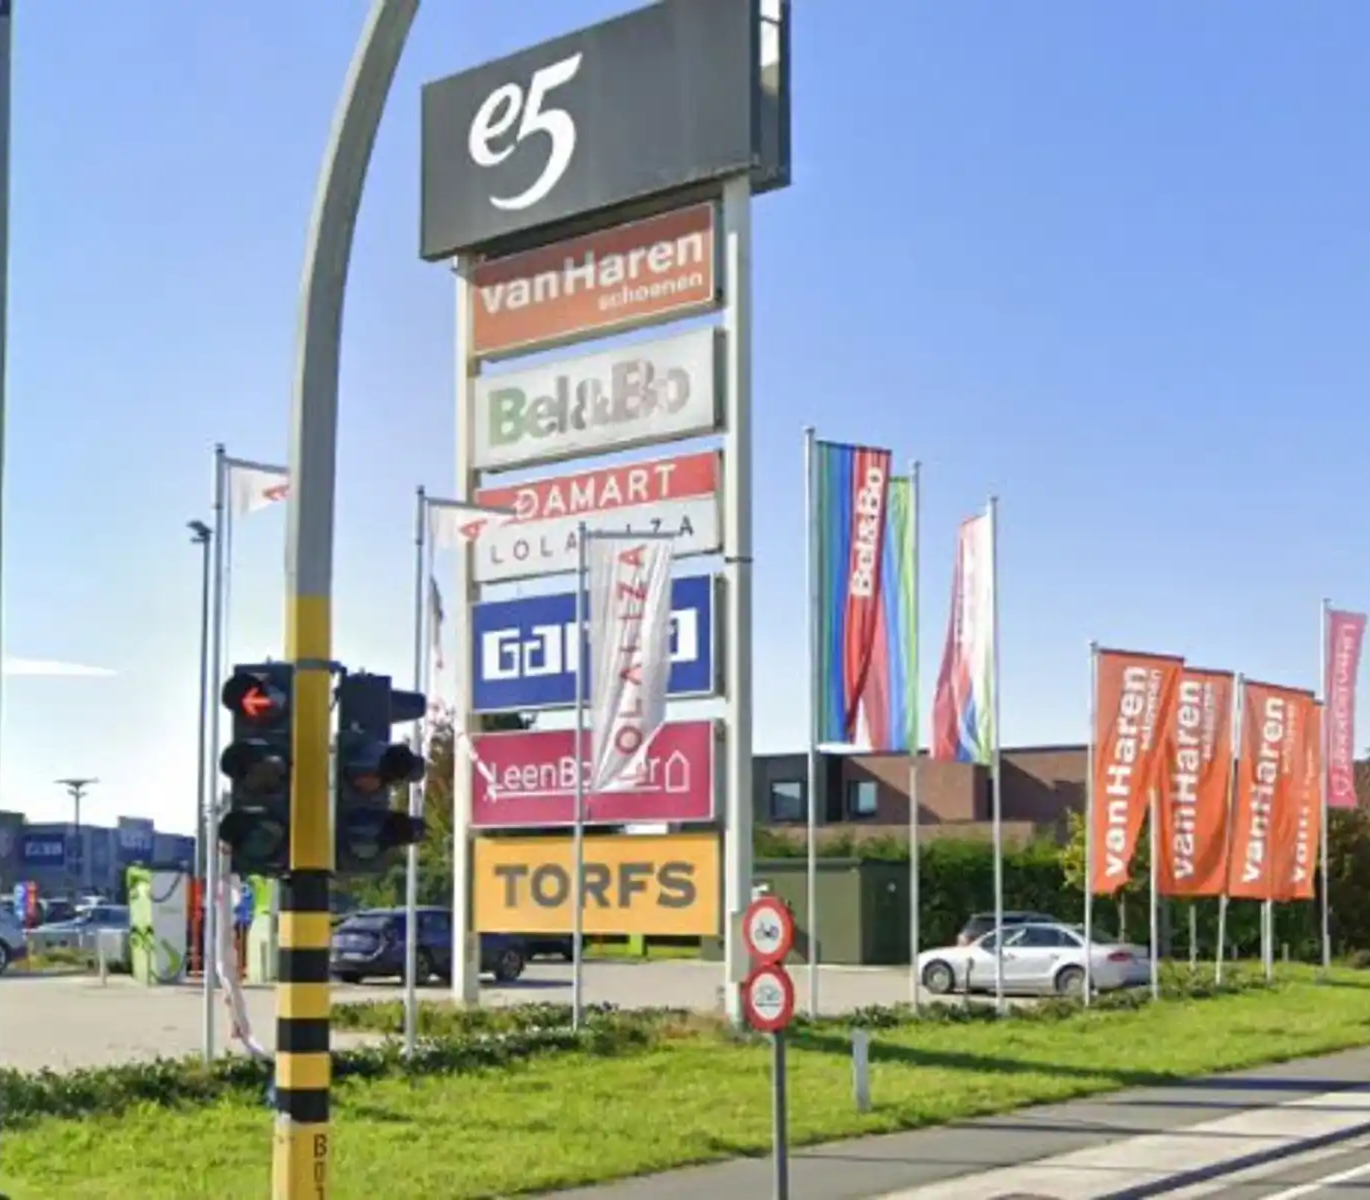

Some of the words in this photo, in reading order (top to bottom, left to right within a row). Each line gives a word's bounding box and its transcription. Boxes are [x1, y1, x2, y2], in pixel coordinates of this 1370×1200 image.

[468, 51, 583, 211] e5
[481, 231, 704, 314] vanHaren
[597, 272, 703, 311] schoenen
[486, 359, 691, 447] Bel&Bo
[513, 463, 677, 520] DAMART
[1105, 666, 1148, 878] vanHaren
[1171, 680, 1202, 880] vanHaren
[493, 860, 697, 909] TORFS
